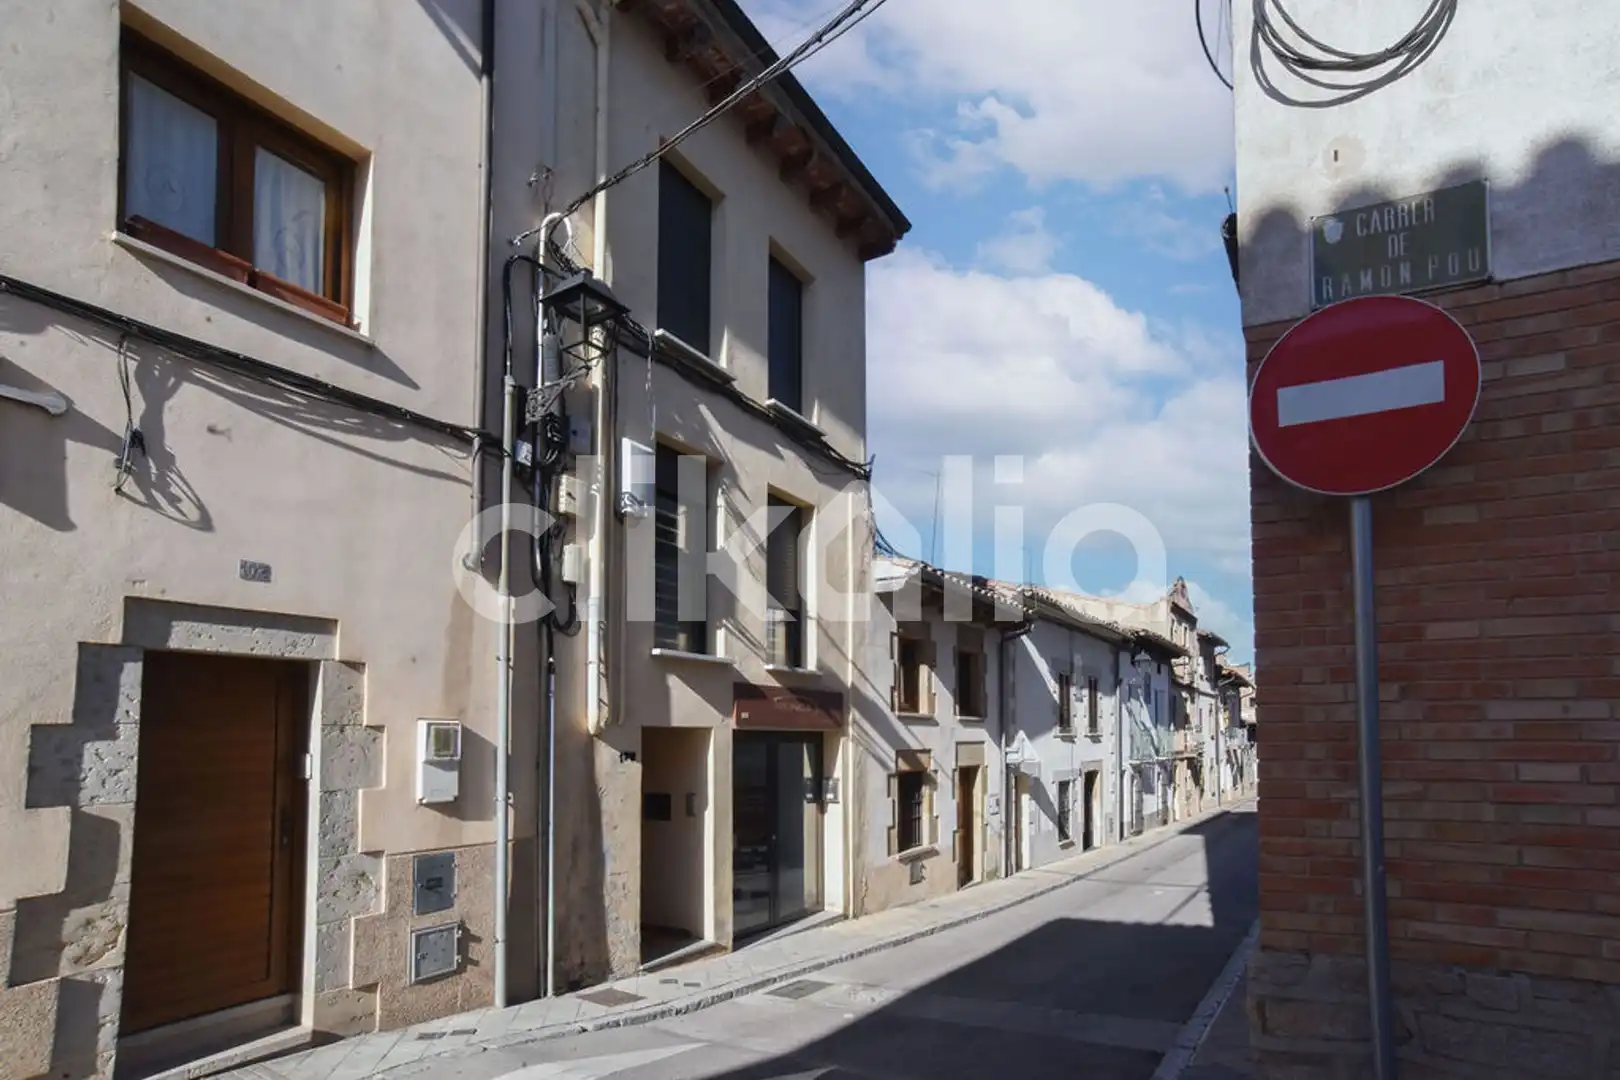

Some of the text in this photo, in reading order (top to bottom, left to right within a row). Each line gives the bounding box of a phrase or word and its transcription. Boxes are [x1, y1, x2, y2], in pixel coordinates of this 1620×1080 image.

[1356, 199, 1435, 237] CARRER
[1387, 231, 1410, 260] DE
[1322, 248, 1480, 300] RAMON POU
